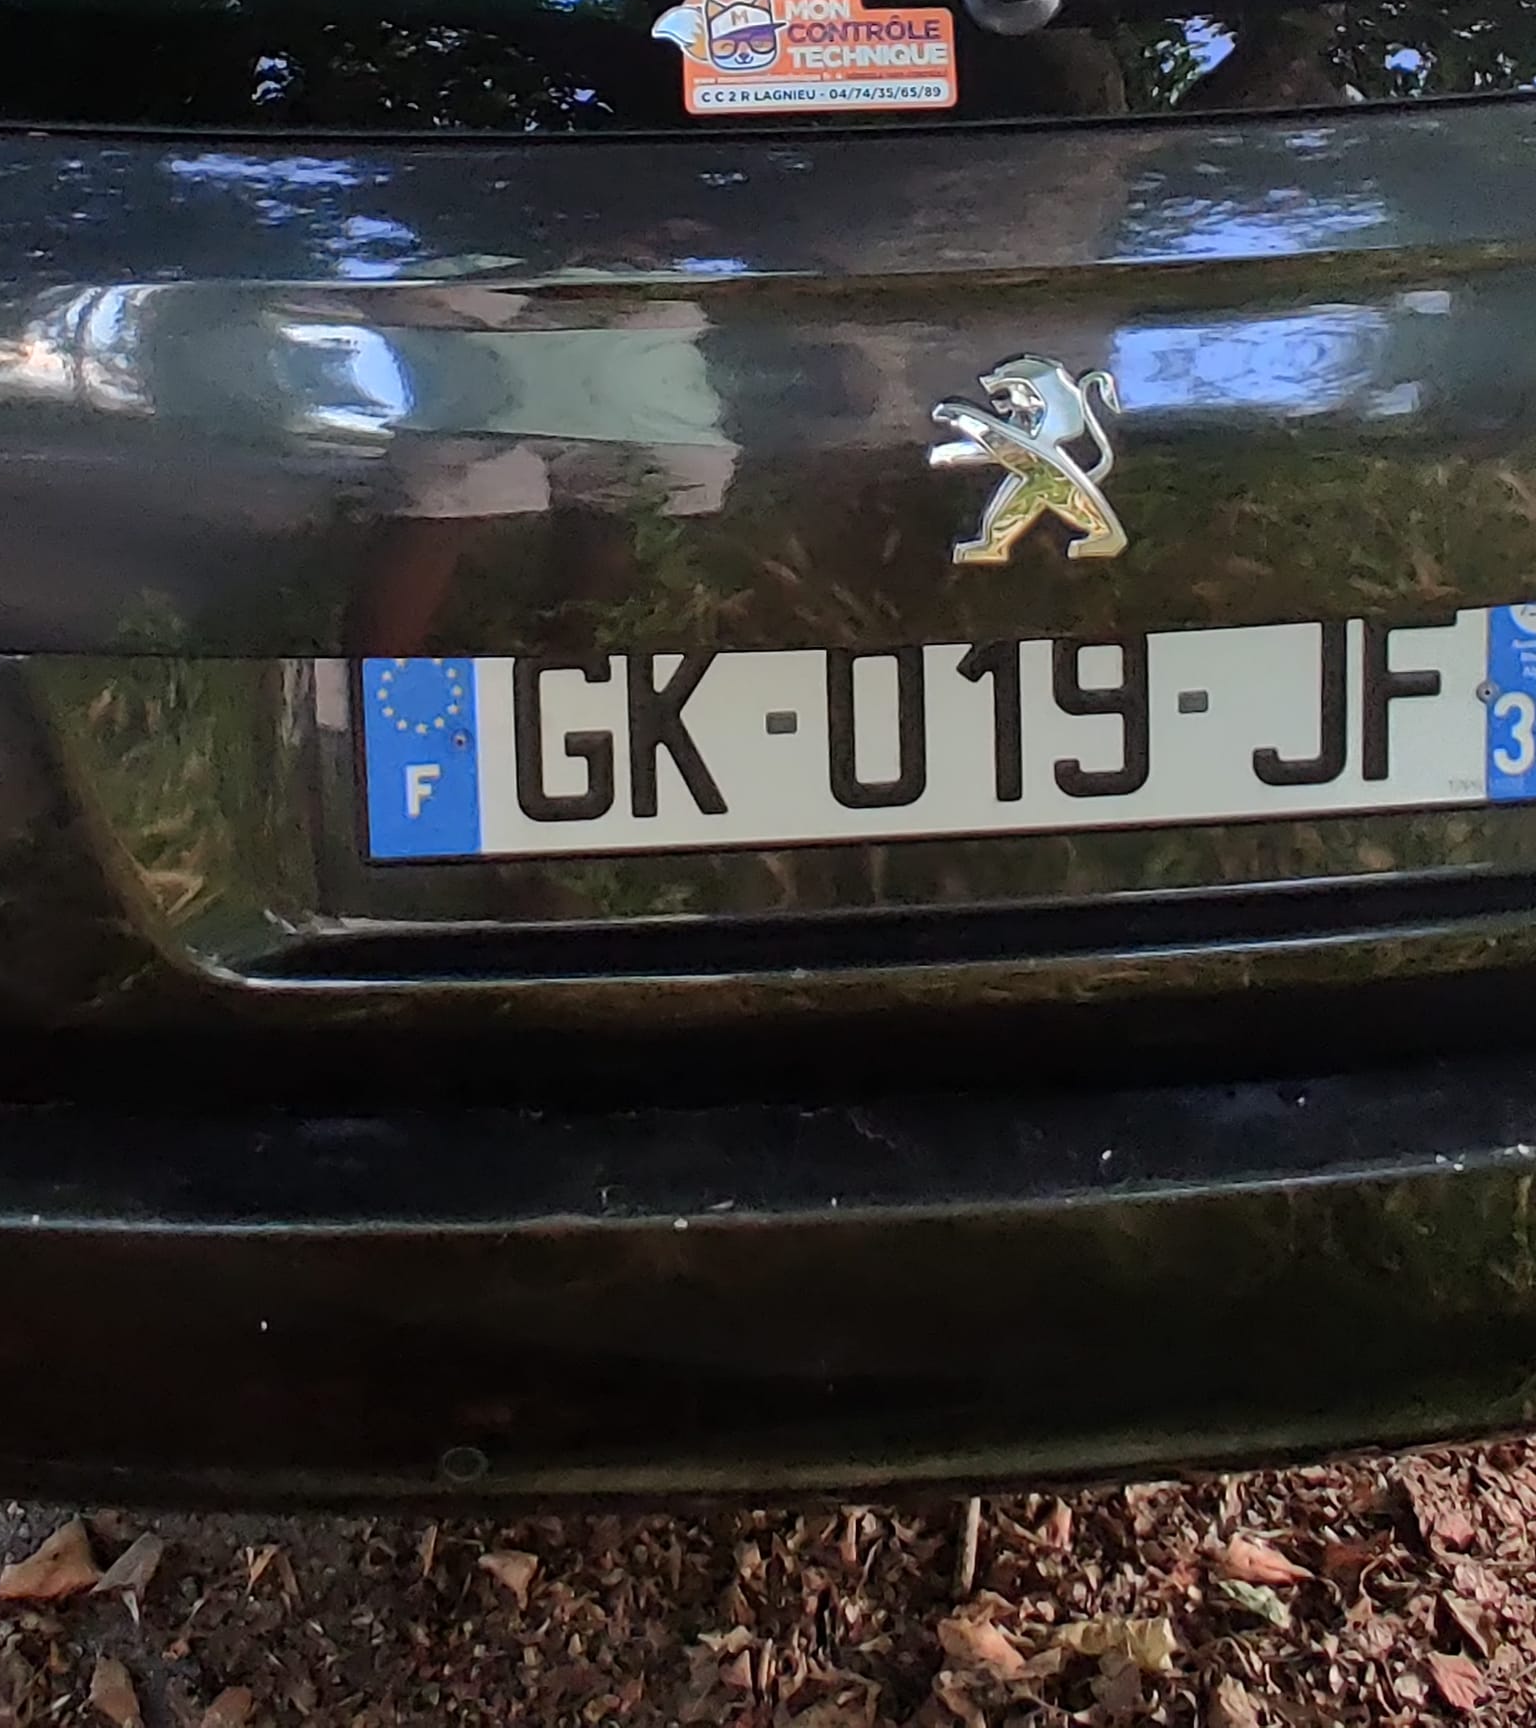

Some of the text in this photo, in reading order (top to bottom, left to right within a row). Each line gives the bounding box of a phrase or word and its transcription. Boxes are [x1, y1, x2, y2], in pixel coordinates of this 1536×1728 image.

[787, 15, 942, 43] CONTRÔLE
[787, 42, 949, 69] TECHNIQUE
[754, 89, 816, 101] LAGNIEU
[829, 85, 942, 101] 04/74/35/65/89
[405, 762, 441, 819] F
